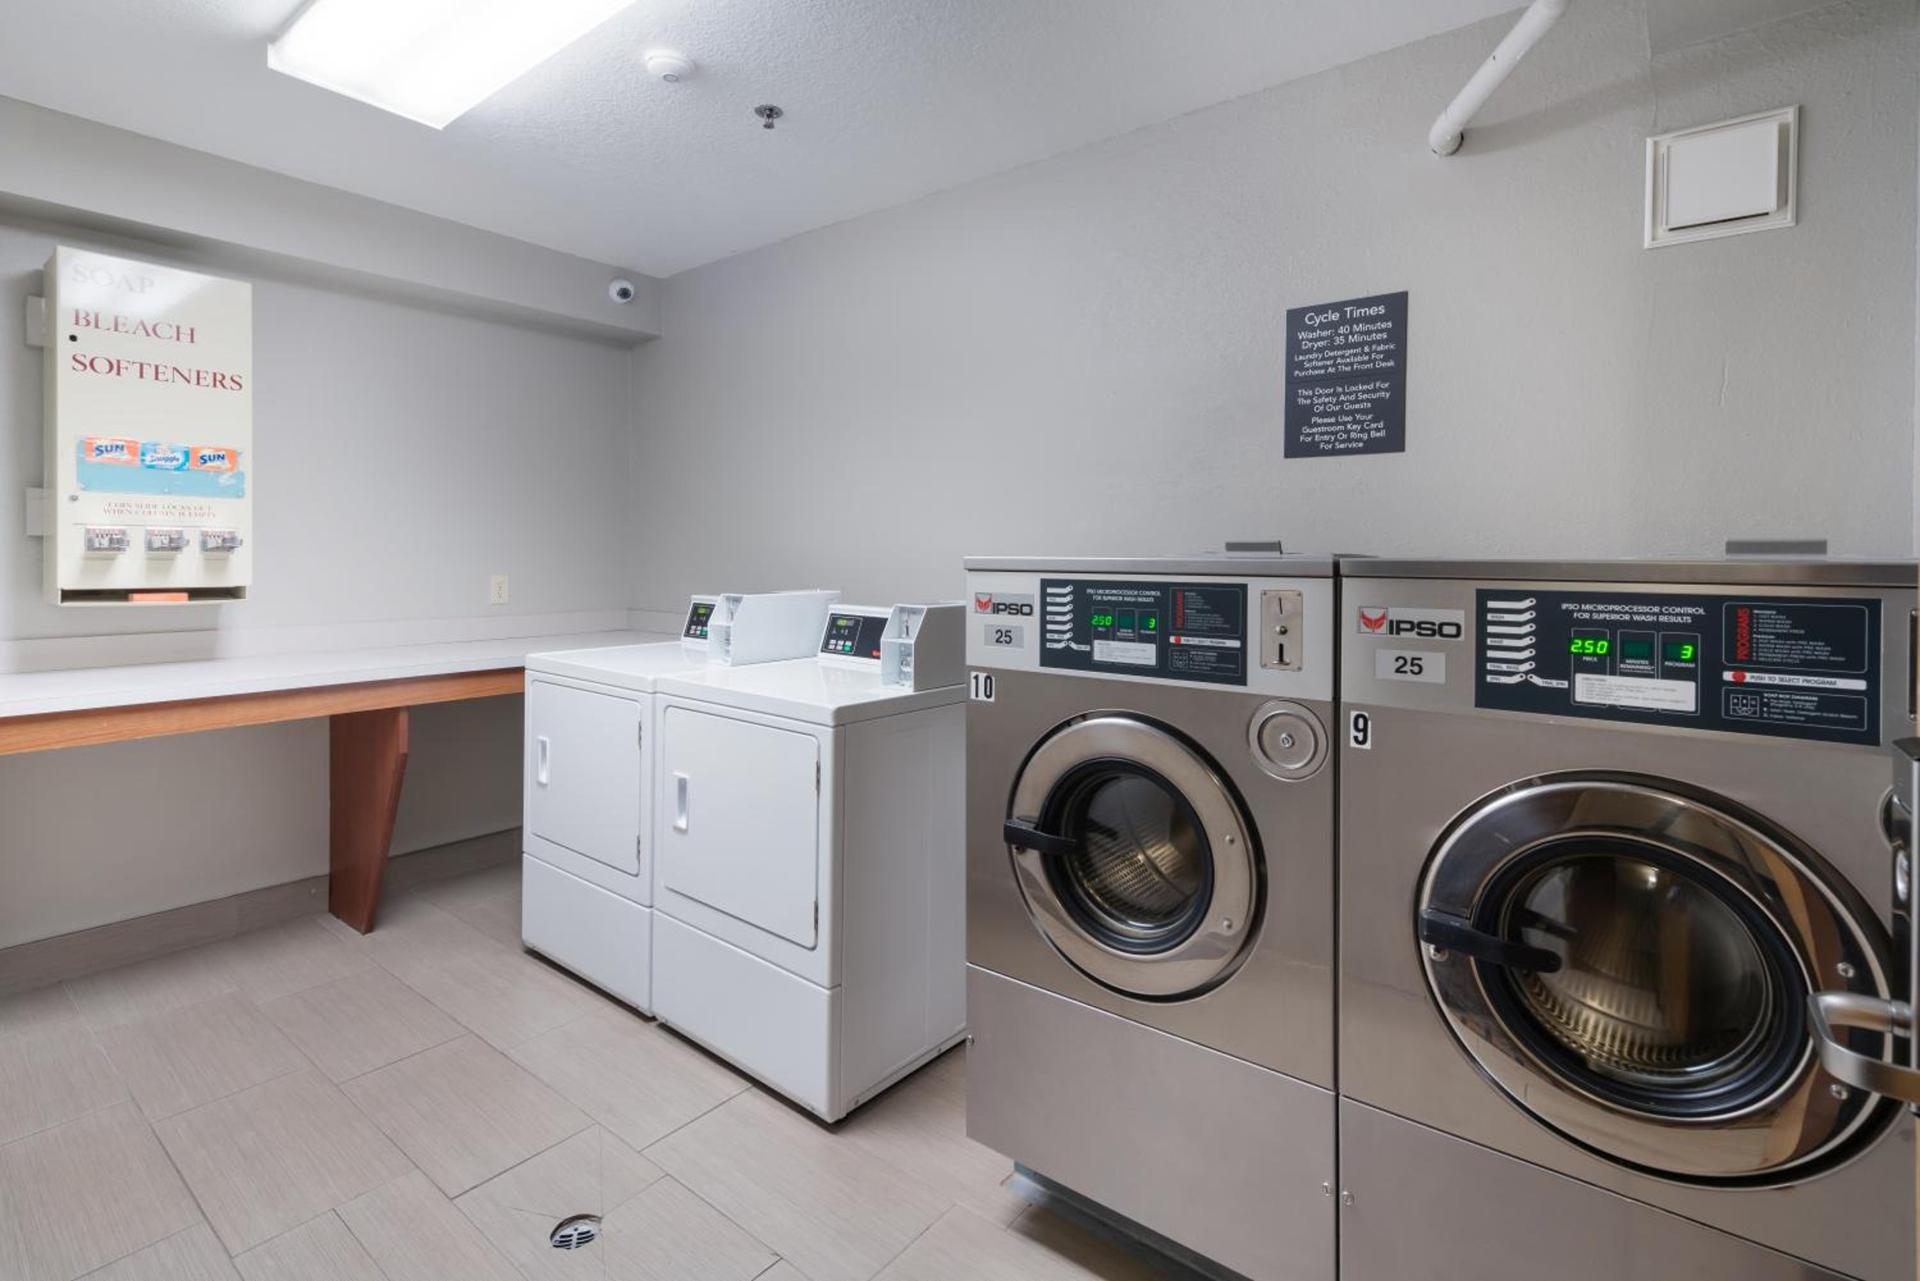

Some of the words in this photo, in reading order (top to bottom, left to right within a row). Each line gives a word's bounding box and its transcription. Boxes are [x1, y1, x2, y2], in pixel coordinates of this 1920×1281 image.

[71, 263, 155, 294] SOAP
[1305, 310, 1340, 327] Cycle
[1344, 305, 1385, 319] Times
[73, 308, 196, 343] BLEACH
[1297, 328, 1335, 339] Washer:
[1338, 325, 1350, 334] 40
[1352, 321, 1392, 333] Minutes
[1301, 339, 1331, 350] Dryer:
[1333, 336, 1345, 345] 35
[1348, 331, 1388, 343] Minutes
[1294, 351, 1323, 361] Laundry
[1324, 347, 1361, 358] Detergent
[1371, 343, 1396, 352] Fabric
[1303, 359, 1334, 368] Softener
[1336, 354, 1369, 364] Available
[1371, 352, 1384, 360] For
[72, 352, 244, 391] SOFTENERS
[1294, 368, 1325, 377] Purchase
[1353, 362, 1373, 371] Front
[1375, 360, 1395, 368] Desk
[1297, 388, 1313, 397] This
[1315, 387, 1334, 395] Door
[1344, 383, 1374, 392] Locked
[1375, 381, 1390, 389] For
[1297, 397, 1312, 405] The
[1312, 395, 1337, 404] Safety
[1357, 391, 1391, 400] Security
[1313, 404, 1324, 413] Of
[1325, 403, 1342, 411] Our
[1343, 402, 1372, 410] Guests
[1311, 416, 1336, 424] Please
[1355, 413, 1374, 421] Your
[1301, 425, 1345, 434] Guestroom
[1347, 424, 1361, 433] Key
[1363, 421, 1384, 429] Card
[1300, 435, 1313, 443] For
[1315, 434, 1335, 443] Entry
[1337, 432, 1348, 440] Or
[1350, 432, 1369, 441] Ring
[1370, 429, 1386, 438] Bell
[94, 443, 125, 457] SUN
[1320, 442, 1333, 450] For
[1334, 440, 1364, 449] Service
[199, 453, 226, 465] SUN
[992, 602, 1034, 616] IPSO
[1581, 604, 1660, 613] MICROPROCESSOR
[1662, 606, 1706, 615] CONTROL
[1148, 617, 1156, 629] 3
[1592, 612, 1631, 621] SUPERIOR
[1633, 614, 1657, 622] WASH
[1659, 615, 1693, 623] RESULTS
[995, 628, 1013, 645] 25
[1388, 619, 1462, 639] IPSO
[1570, 639, 1609, 655] 2.50
[1680, 645, 1694, 659] 3
[1394, 656, 1424, 675] 25
[972, 673, 993, 699] 10
[1353, 712, 1369, 746] 9
